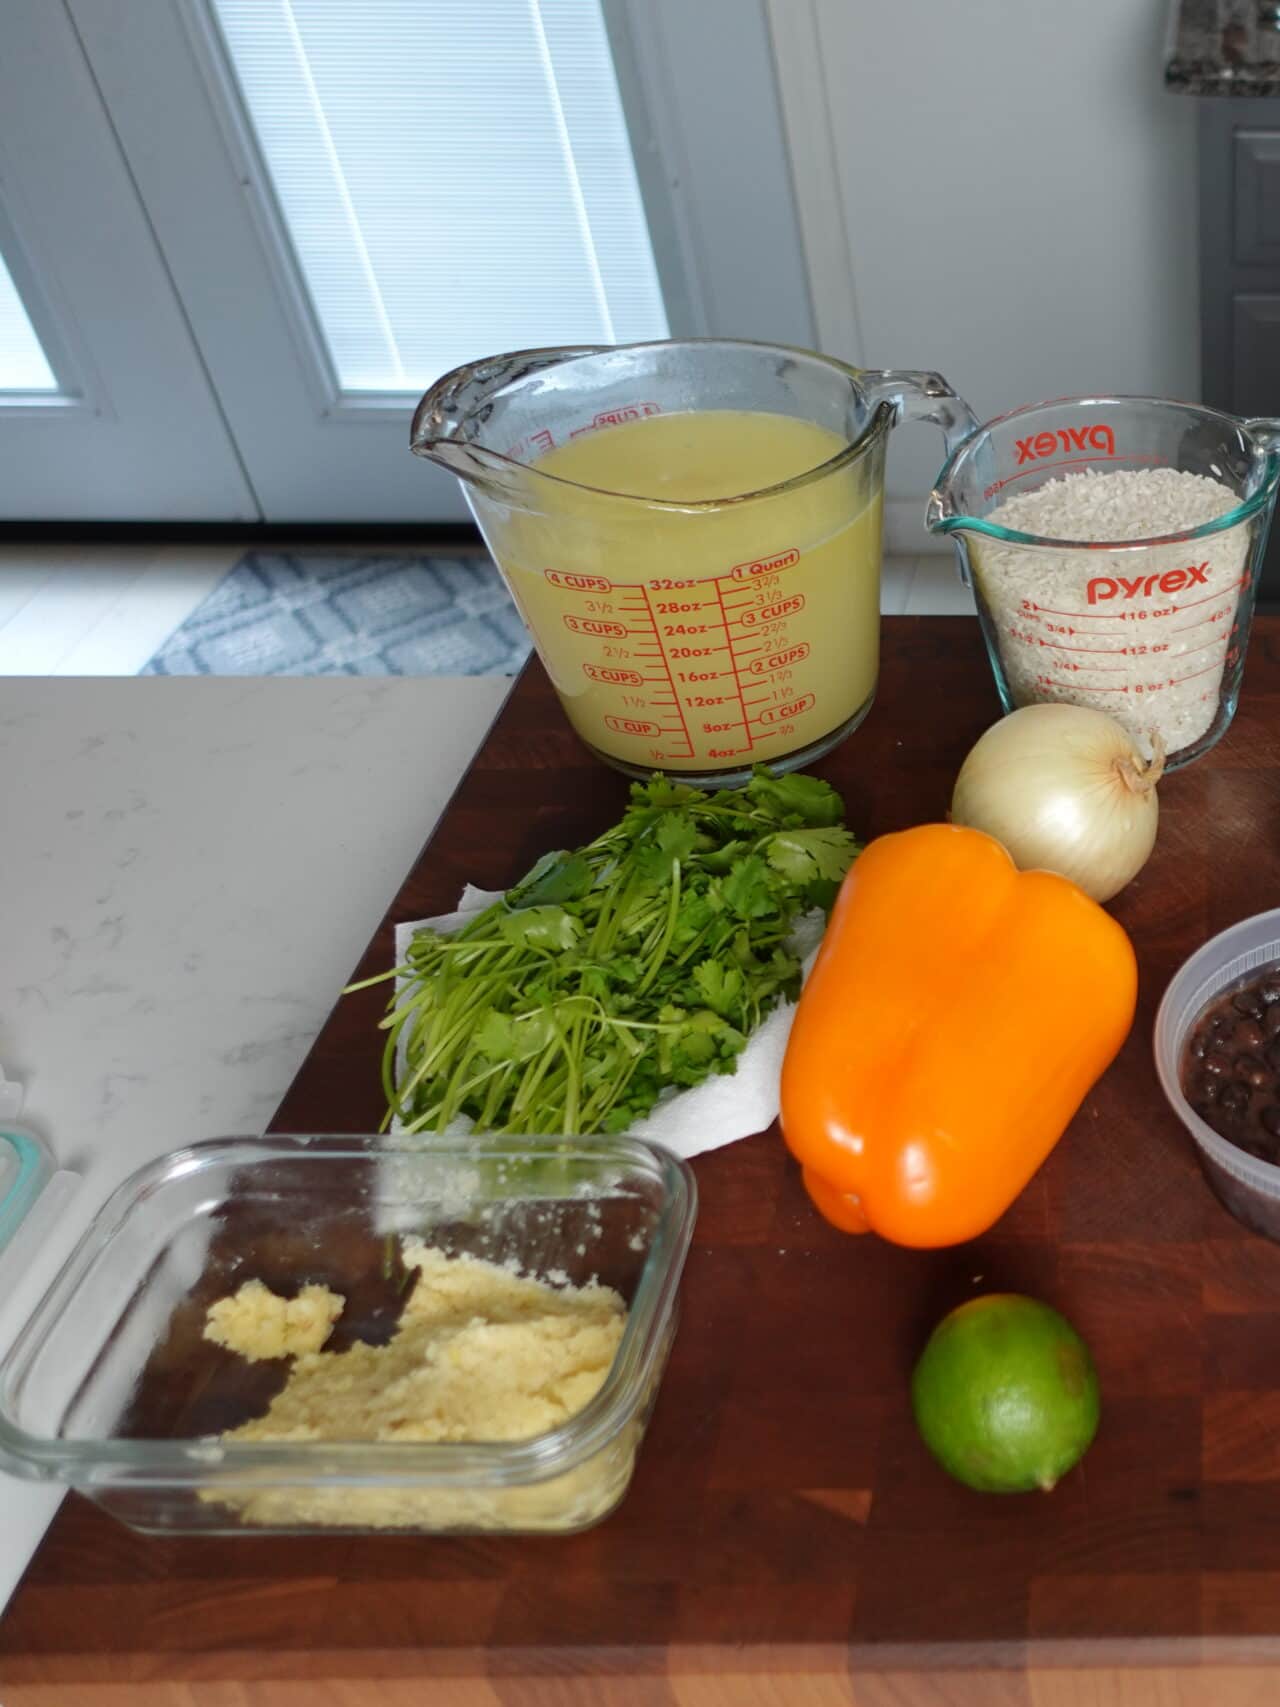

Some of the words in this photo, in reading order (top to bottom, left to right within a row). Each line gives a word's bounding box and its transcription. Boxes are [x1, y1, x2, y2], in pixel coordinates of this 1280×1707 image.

[735, 568, 743, 578] 1
[750, 553, 795, 575] Quart
[564, 575, 608, 591] CUPS
[649, 579, 697, 592] 32oz
[1086, 561, 1210, 605] pyrex
[656, 602, 703, 614] 28oz
[746, 613, 756, 624] 3
[760, 597, 801, 620] CUPS
[1022, 600, 1031, 610] 2
[1128, 611, 1147, 621] 16
[1153, 608, 1171, 618] oz
[569, 619, 579, 629] 3
[582, 621, 624, 636] CUPS
[663, 624, 709, 637] 24oz
[669, 647, 713, 659] 20oz
[1129, 645, 1147, 656] 12
[1152, 643, 1170, 653] oz
[754, 661, 764, 673] 2
[768, 647, 806, 668] CUPS
[601, 670, 640, 684] CUPS
[678, 671, 719, 683] 16oz
[1148, 682, 1164, 692] oz
[685, 696, 725, 708] 12oz
[767, 711, 774, 721] 1
[779, 699, 807, 717] CUP
[612, 719, 619, 730] 1
[624, 722, 652, 734] CUP
